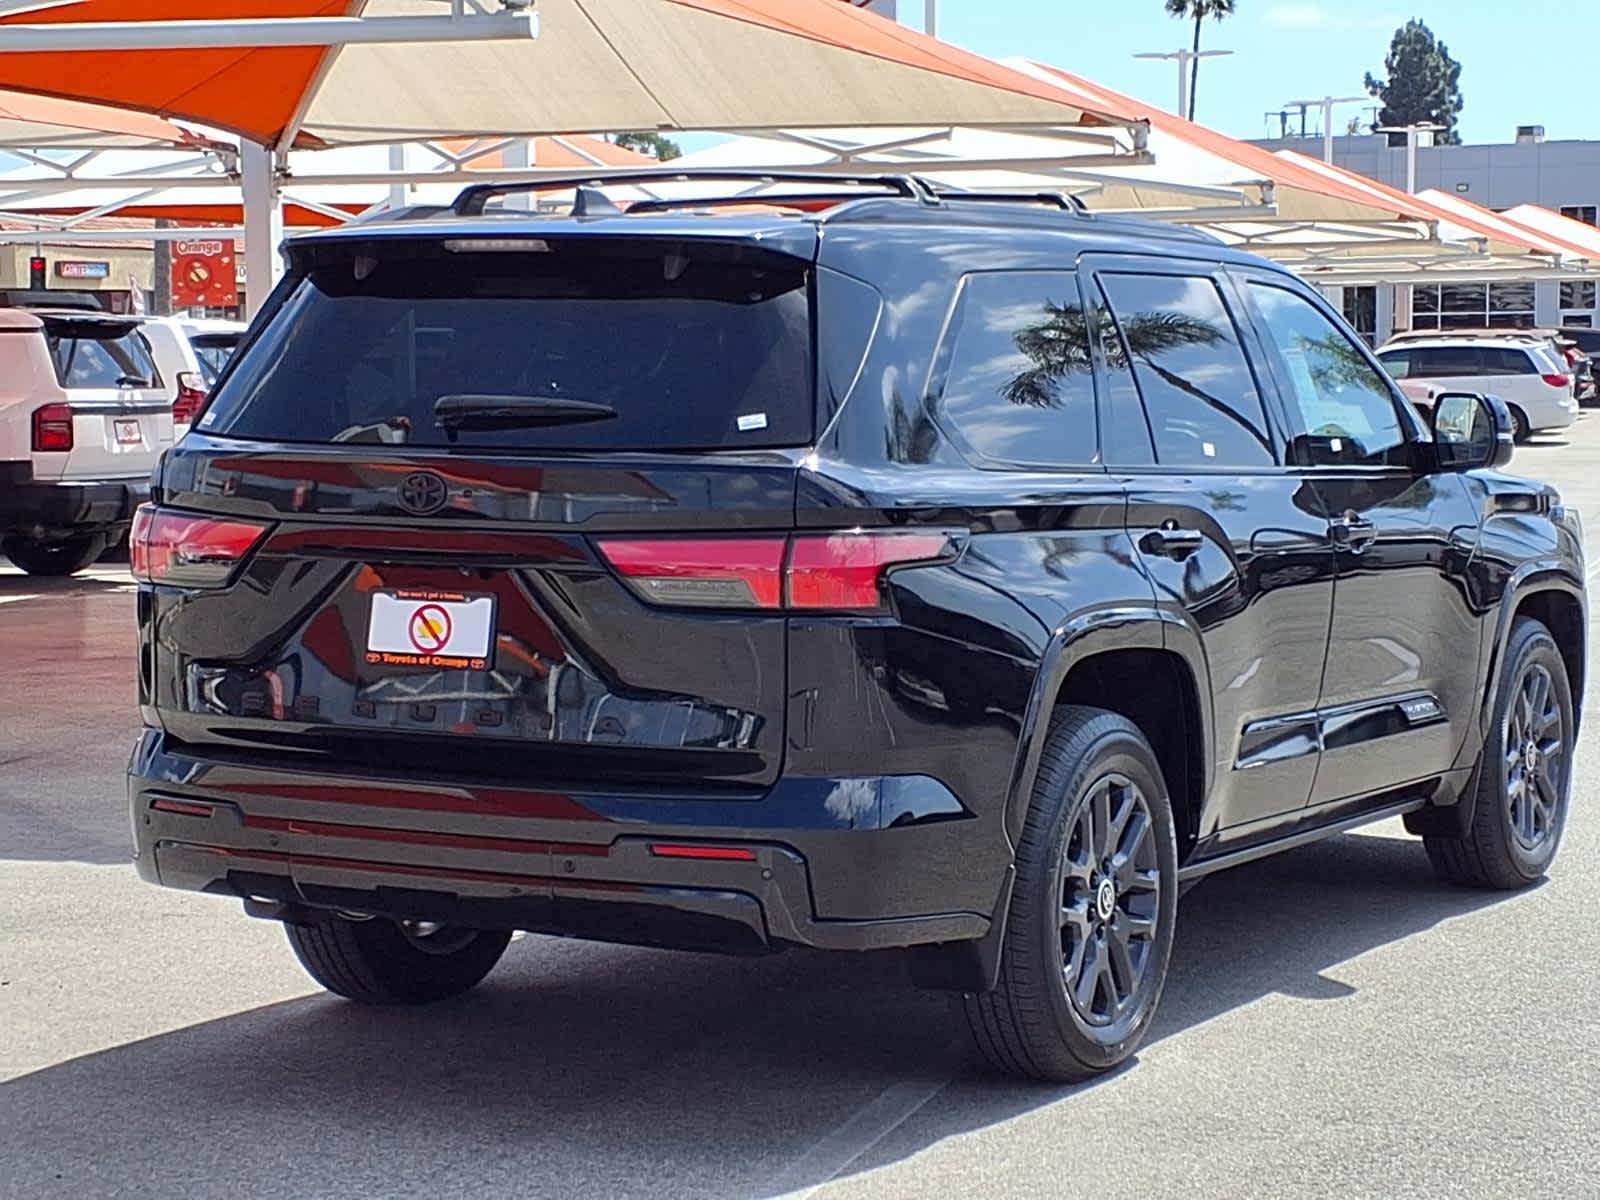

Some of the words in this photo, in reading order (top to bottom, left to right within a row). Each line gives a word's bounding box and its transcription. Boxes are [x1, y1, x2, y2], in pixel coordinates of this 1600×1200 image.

[179, 240, 221, 254] Orange
[383, 653, 417, 665] Toyota
[419, 656, 431, 666] of
[432, 656, 469, 668] Orange
